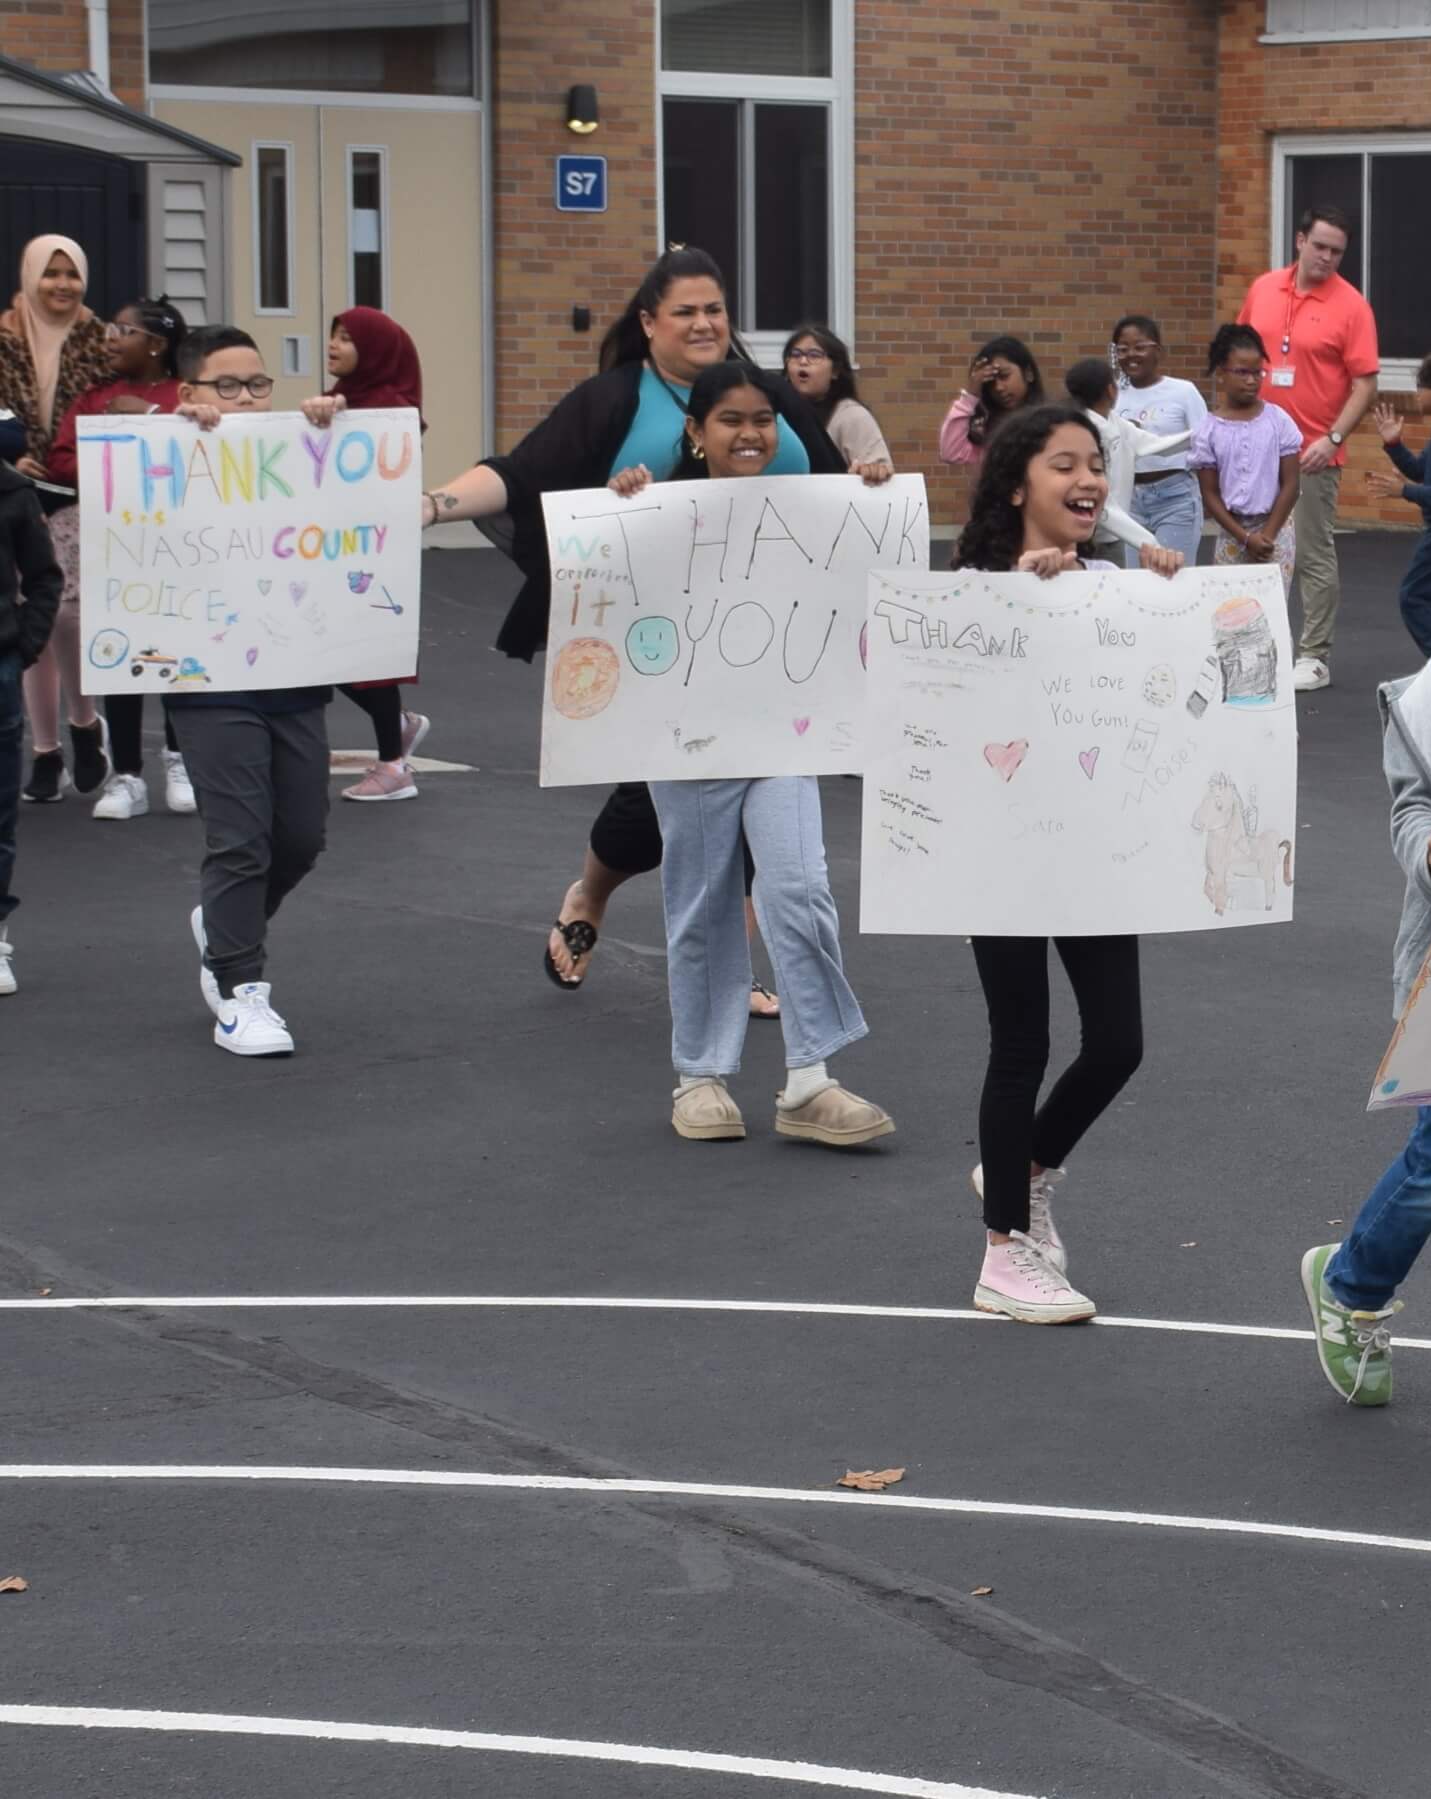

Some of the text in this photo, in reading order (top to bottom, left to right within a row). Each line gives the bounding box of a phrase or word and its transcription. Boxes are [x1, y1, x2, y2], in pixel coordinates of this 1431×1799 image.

[565, 171, 597, 195] S7
[77, 430, 413, 514] THANK YOU
[105, 523, 388, 569] NASSAU COUNTY
[572, 496, 923, 607] THANK
[106, 577, 228, 623] POLICE
[685, 598, 838, 687] YOU
[874, 599, 1029, 658] THANK
[1041, 673, 1126, 696] WE LOVE
